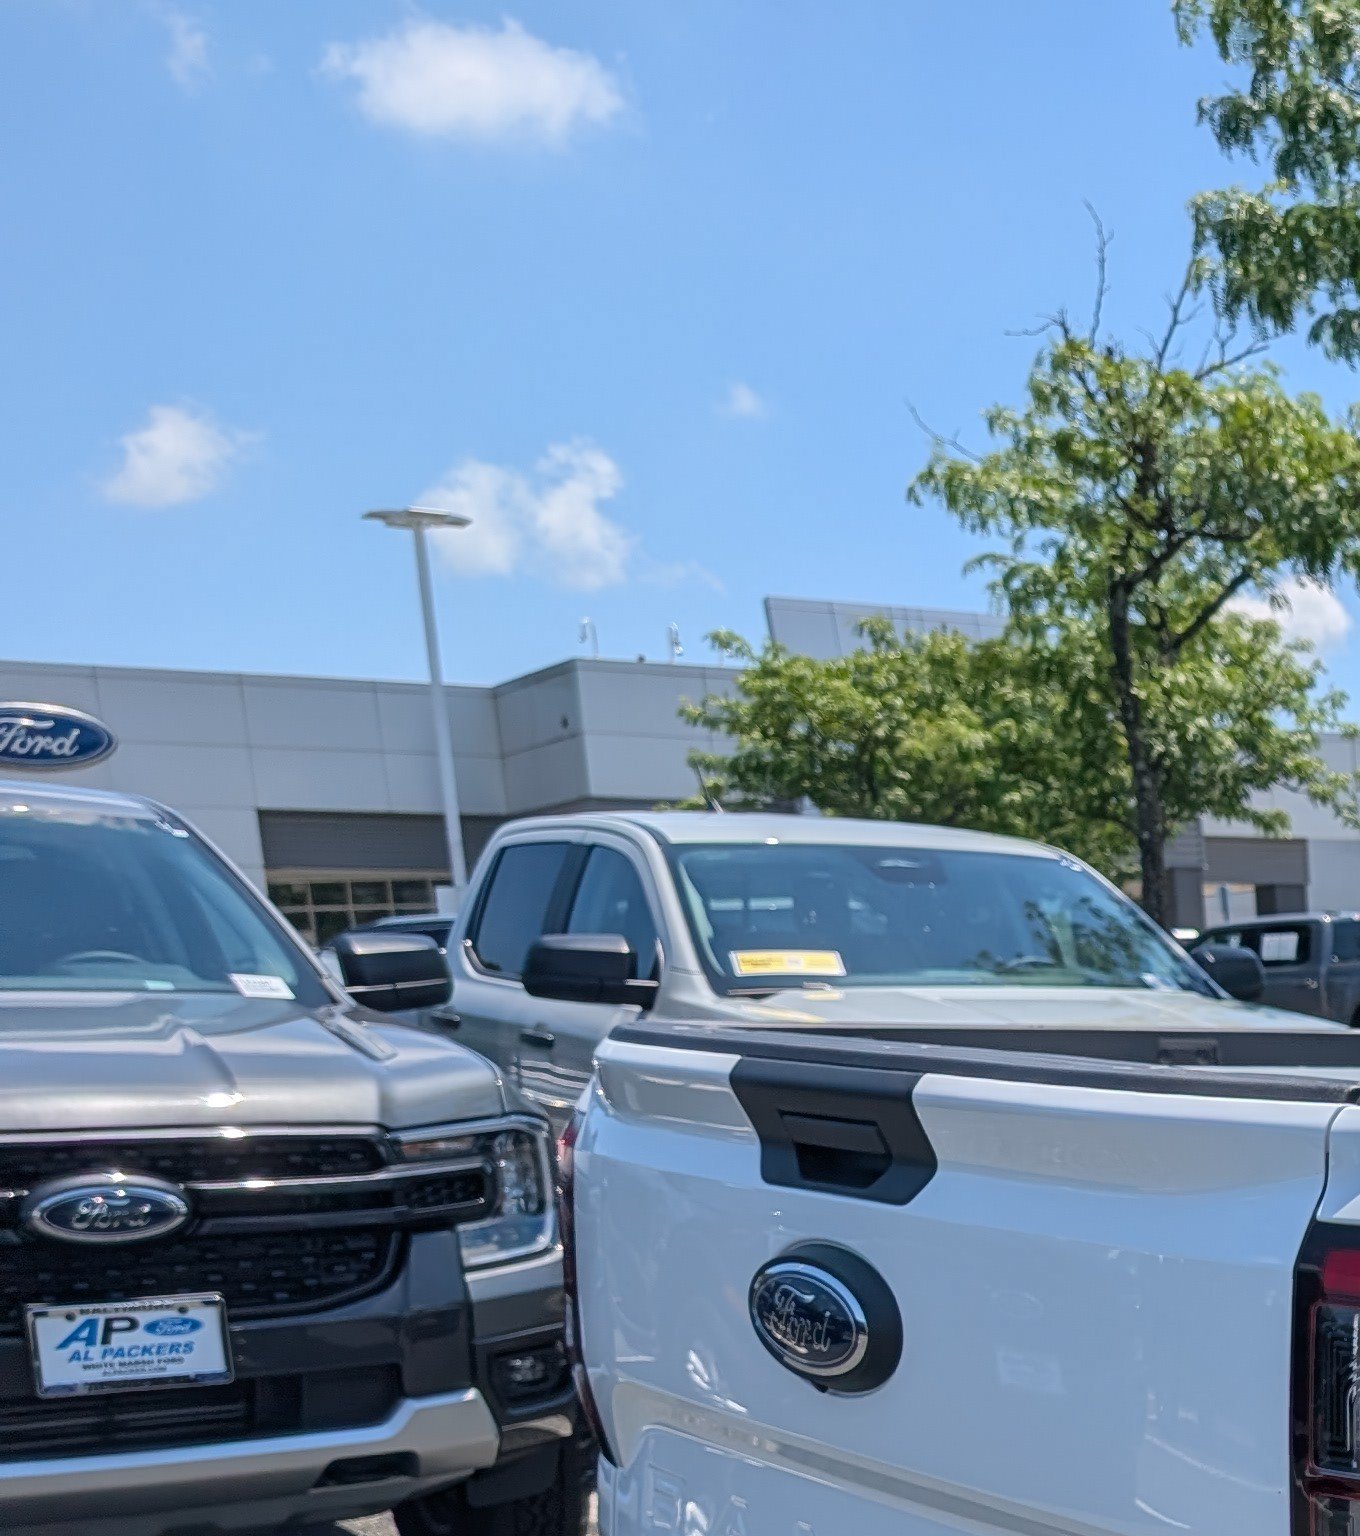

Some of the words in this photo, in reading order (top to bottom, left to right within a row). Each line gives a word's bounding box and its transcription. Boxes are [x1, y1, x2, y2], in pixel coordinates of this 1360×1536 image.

[0, 717, 81, 756] Ford
[71, 1197, 151, 1230] Ford
[56, 1316, 139, 1350] AP
[763, 1283, 832, 1354] Ford
[68, 1349, 95, 1363] AL
[101, 1340, 195, 1360] PACKERS
